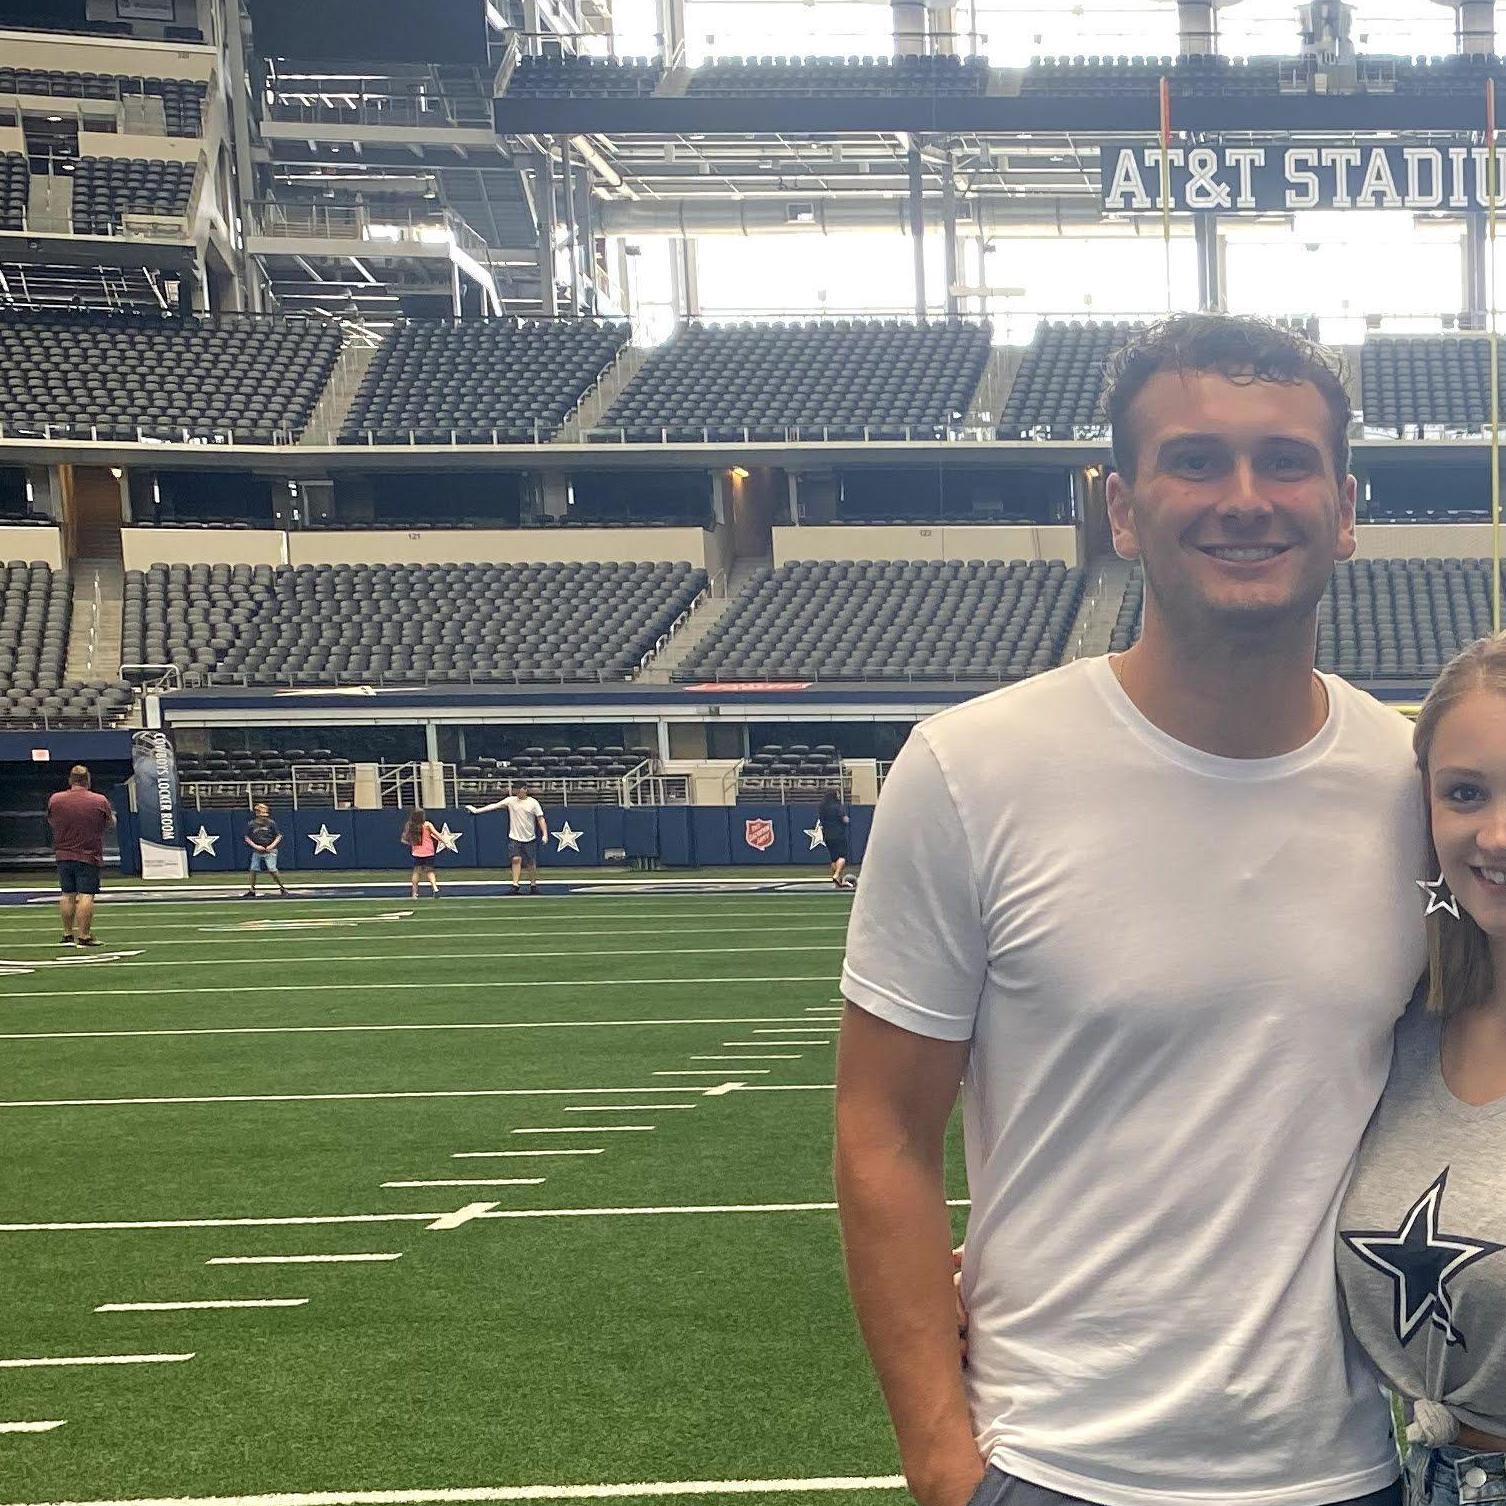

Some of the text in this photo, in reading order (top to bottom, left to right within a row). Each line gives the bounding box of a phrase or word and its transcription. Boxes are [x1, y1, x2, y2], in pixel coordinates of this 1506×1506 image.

[1105, 148, 1266, 209] AT&T
[153, 732, 175, 840] COWBOYS LOCKER ROOM
